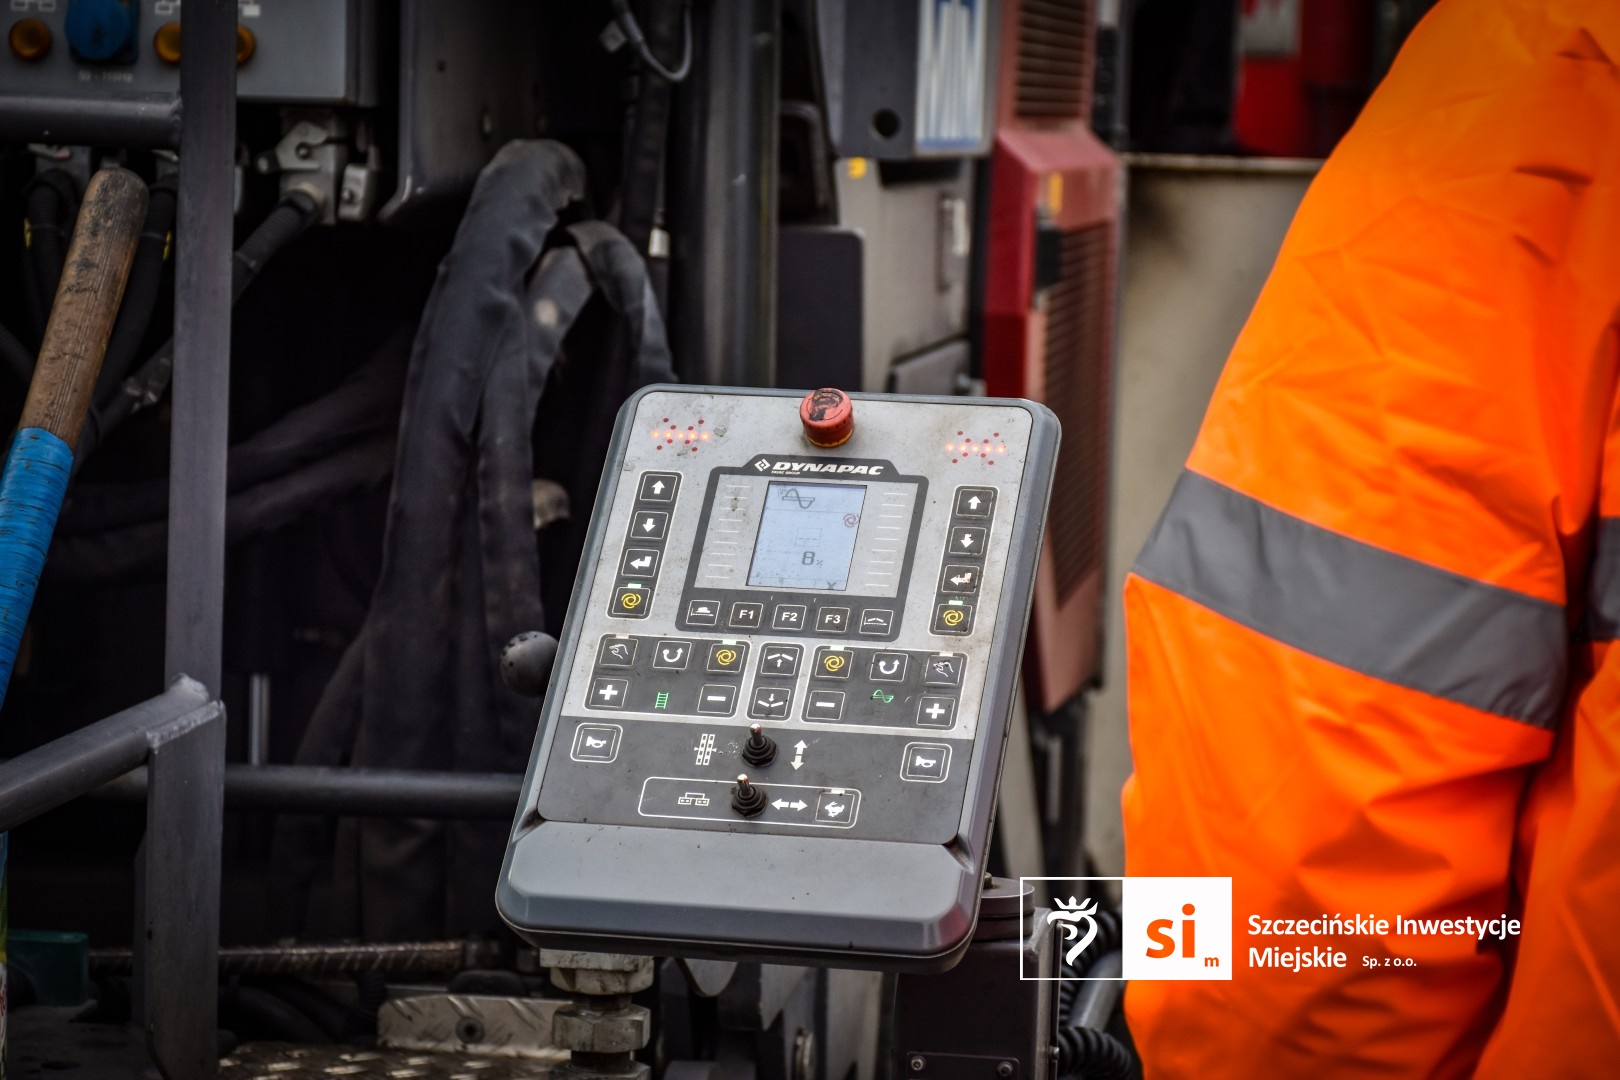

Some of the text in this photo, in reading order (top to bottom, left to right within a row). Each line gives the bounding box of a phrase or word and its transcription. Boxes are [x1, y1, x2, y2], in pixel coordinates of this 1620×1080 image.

[772, 461, 885, 475] DYNAPAC
[739, 609, 755, 620] F1
[781, 612, 798, 622] F2
[824, 614, 841, 624] F3
